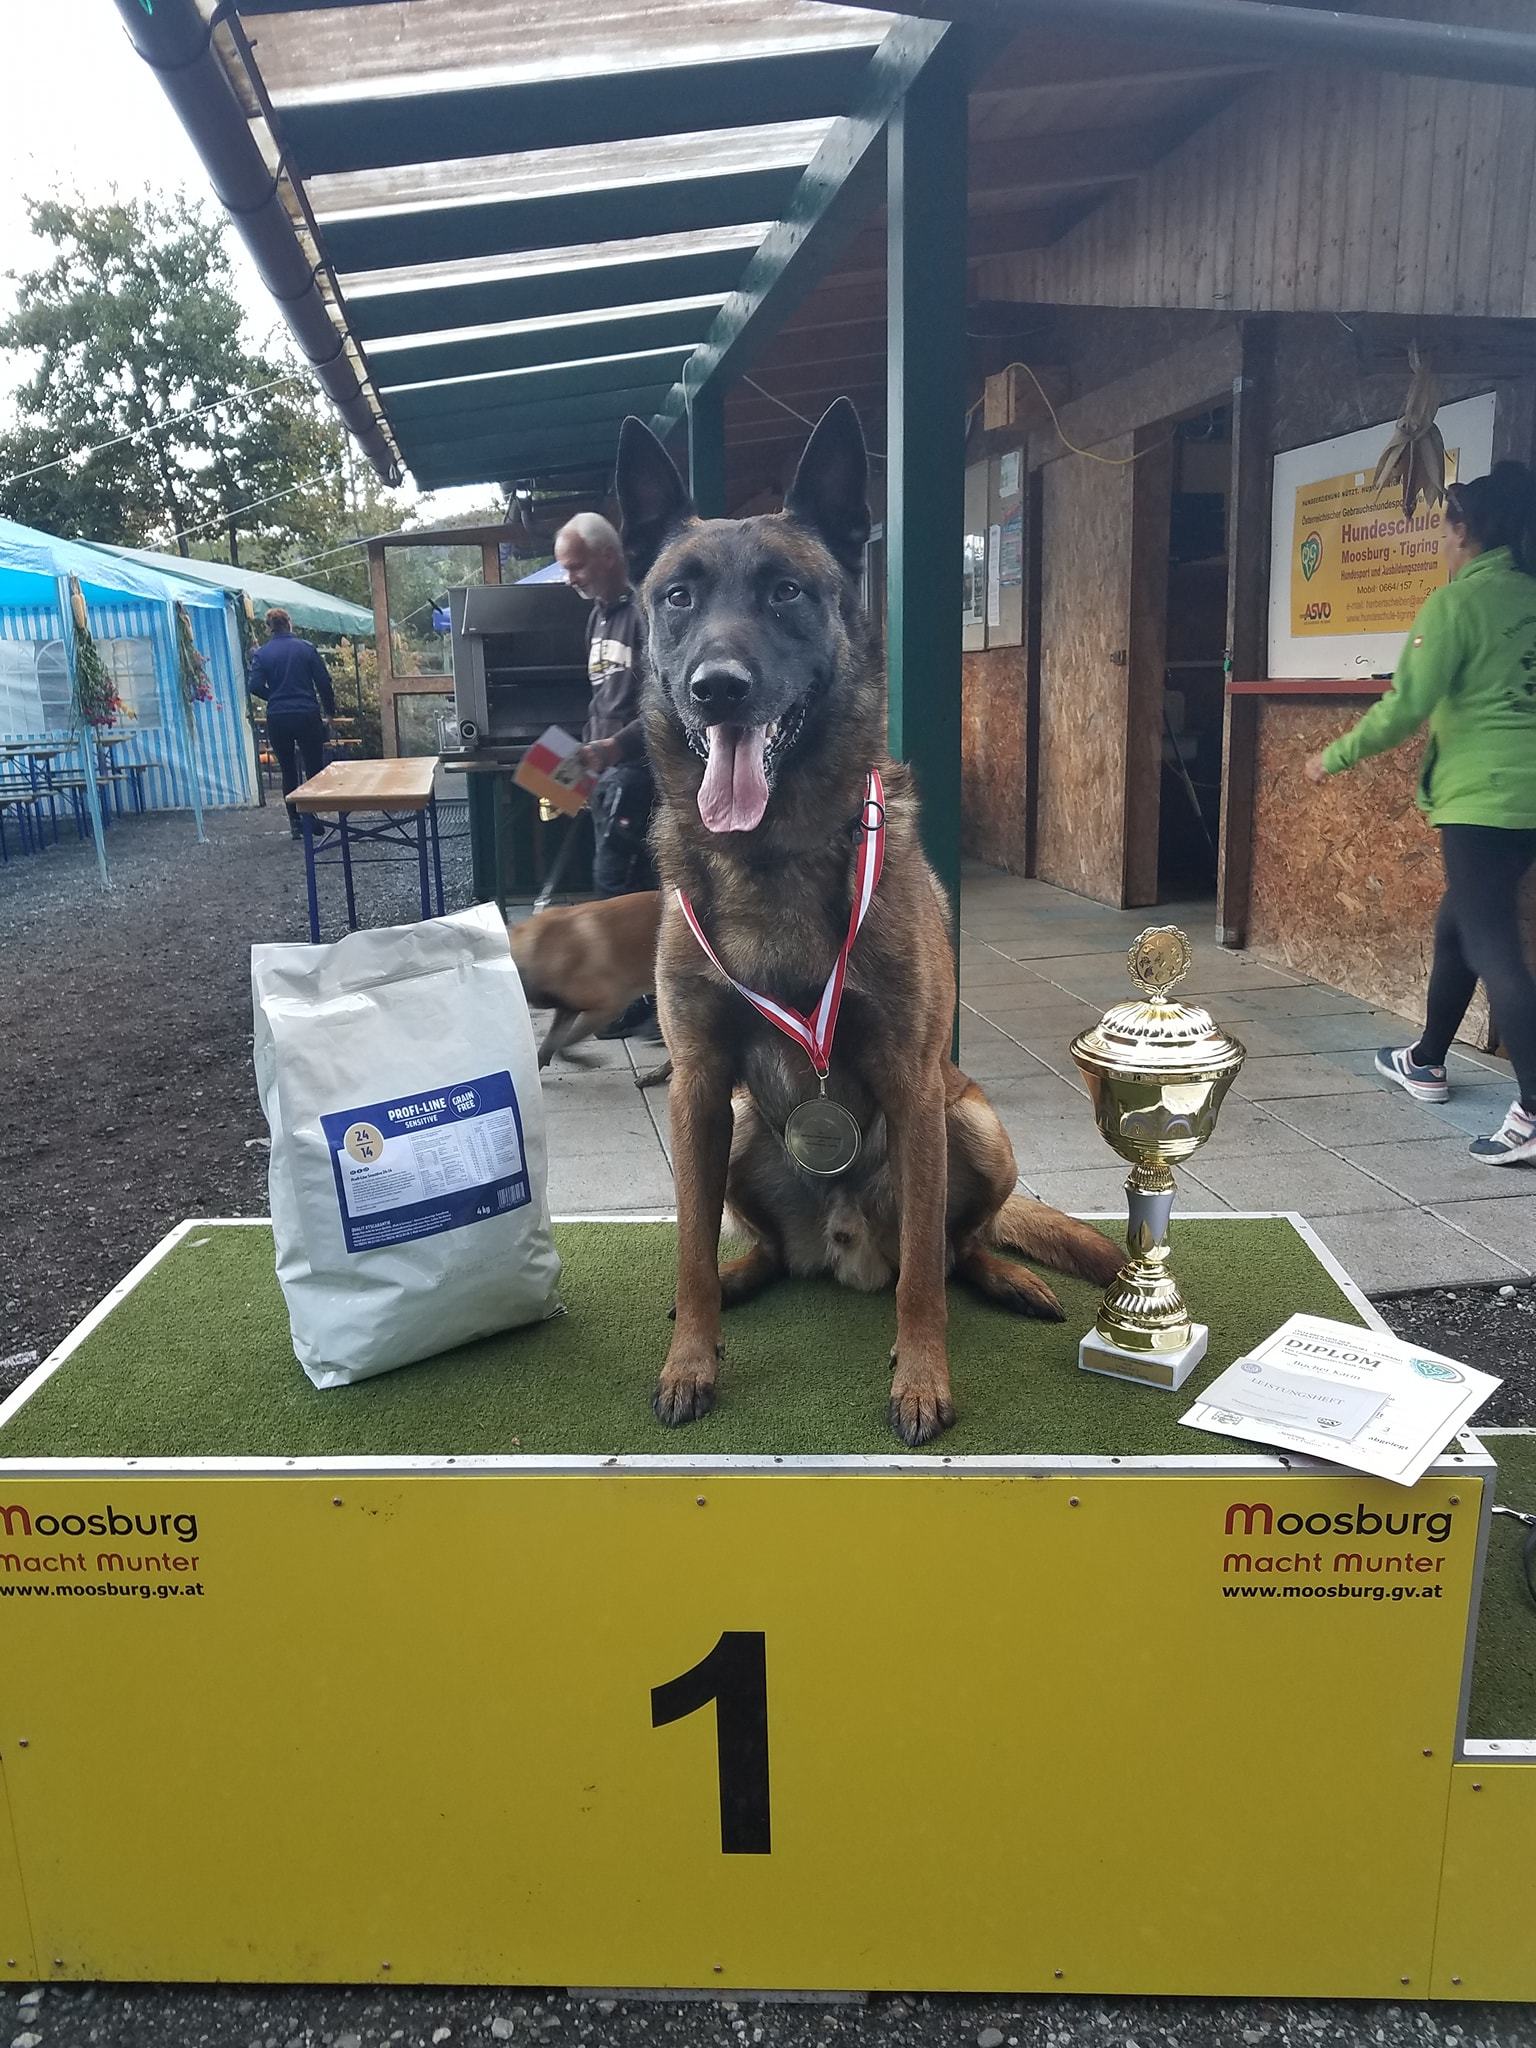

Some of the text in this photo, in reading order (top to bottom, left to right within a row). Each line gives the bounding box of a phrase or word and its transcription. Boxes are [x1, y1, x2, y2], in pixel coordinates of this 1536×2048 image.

[1341, 512, 1441, 543] Hundeschule
[1341, 546, 1390, 564] Moosburg
[1399, 539, 1439, 559] Tigring
[1341, 562, 1438, 581] Hundesport und Ausbildungszentrum
[388, 1090, 475, 1121] PROFI-LINE GRAIN
[457, 1100, 476, 1113] FREE
[405, 1114, 438, 1129] SENSITIVE
[355, 1129, 370, 1142] 24
[360, 1145, 373, 1158] 14
[476, 1205, 491, 1216] 4 kg
[1286, 1339, 1382, 1369] DIPLOM
[1251, 1377, 1345, 1406] LEISTUNGSHEFT
[1224, 1502, 1453, 1543] Moosburg
[96, 1552, 200, 1572] Munter
[1222, 1551, 1446, 1574] Macht Munter
[0, 1582, 205, 1599] www.moosburg.gv.at
[1222, 1583, 1444, 1600] www.moosburg.gv.at
[650, 1630, 772, 1855] 1
